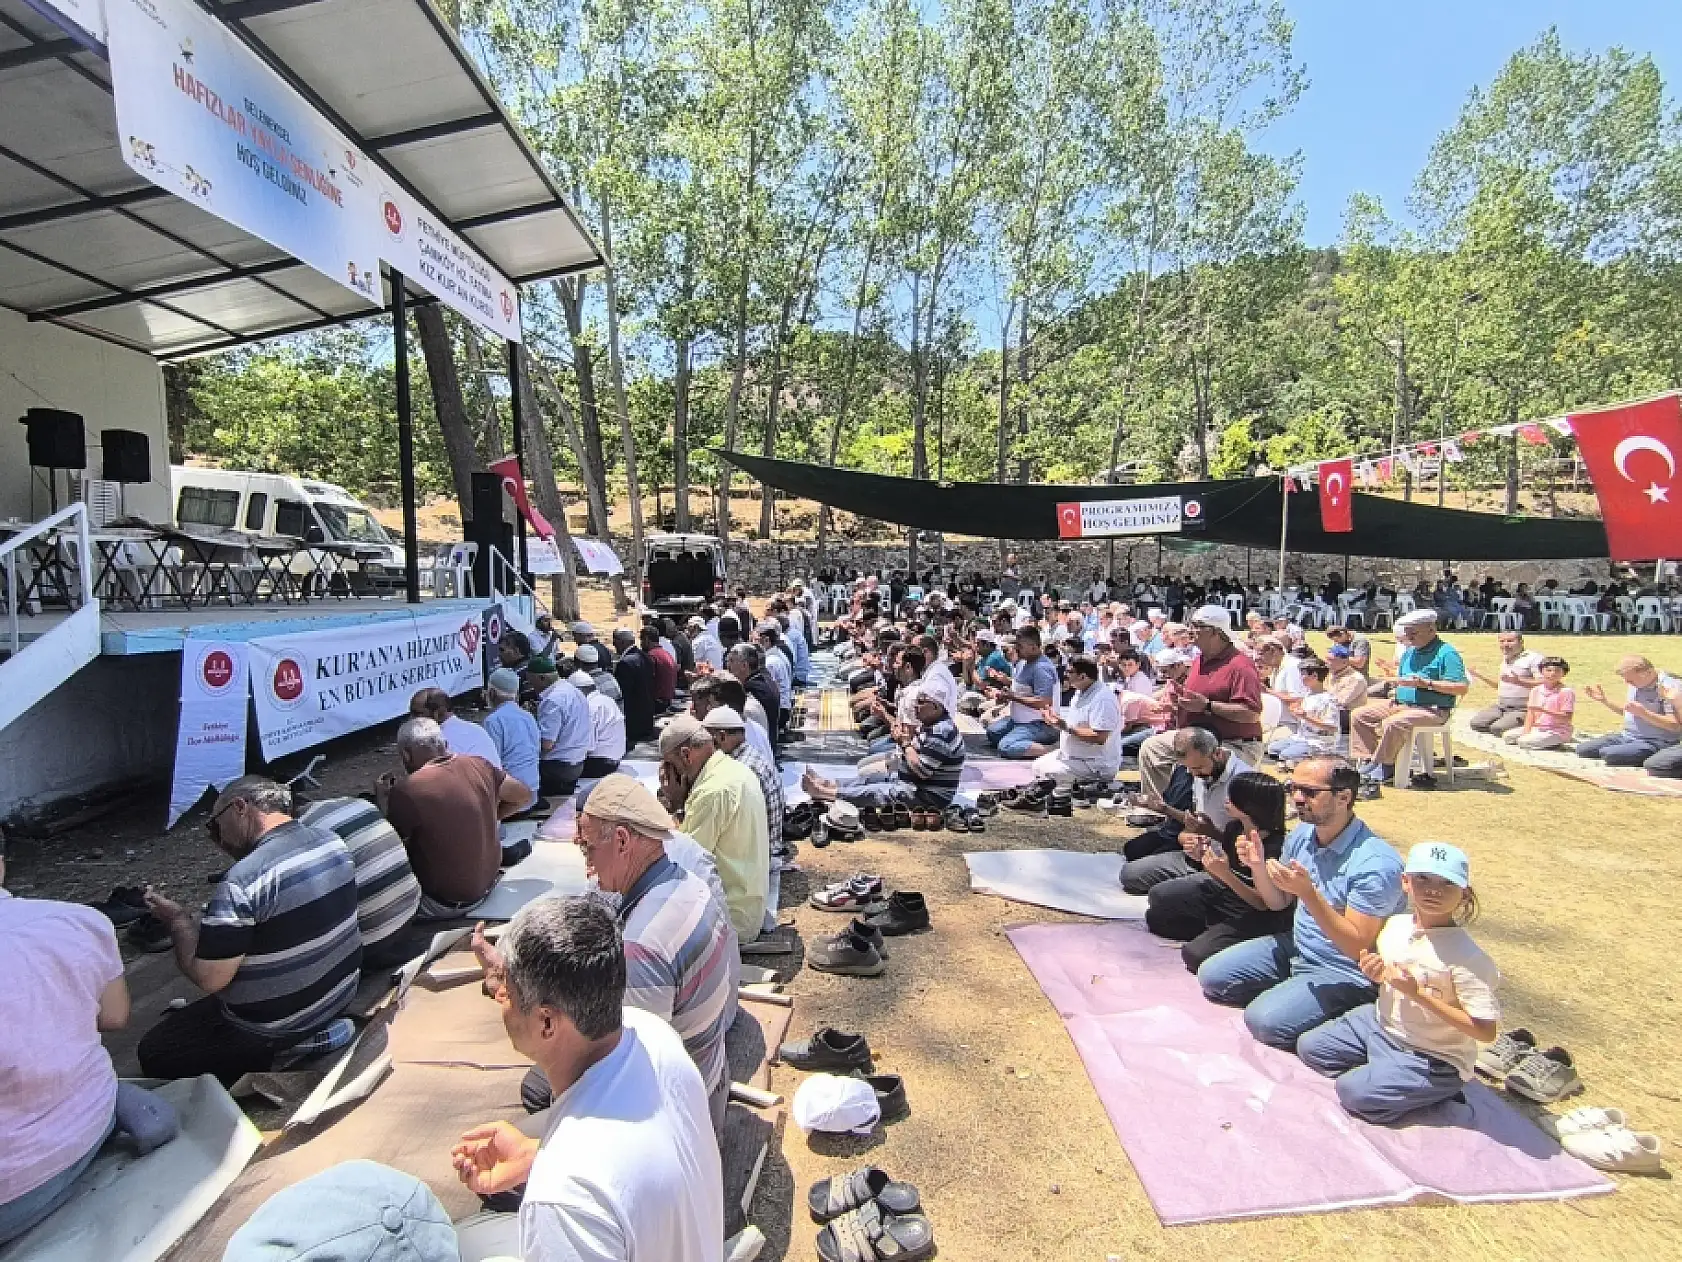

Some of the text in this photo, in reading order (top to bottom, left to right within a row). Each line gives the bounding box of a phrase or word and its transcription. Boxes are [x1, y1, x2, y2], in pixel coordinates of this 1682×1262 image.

[173, 62, 247, 136] HAFIZLAR
[1082, 502, 1179, 515] PROGRAMIMIZA
[1083, 517, 1109, 530] HOŞ
[316, 645, 404, 679] KUR'AN'A
[318, 688, 341, 710] EN
[344, 671, 398, 703] BÜYÜK
